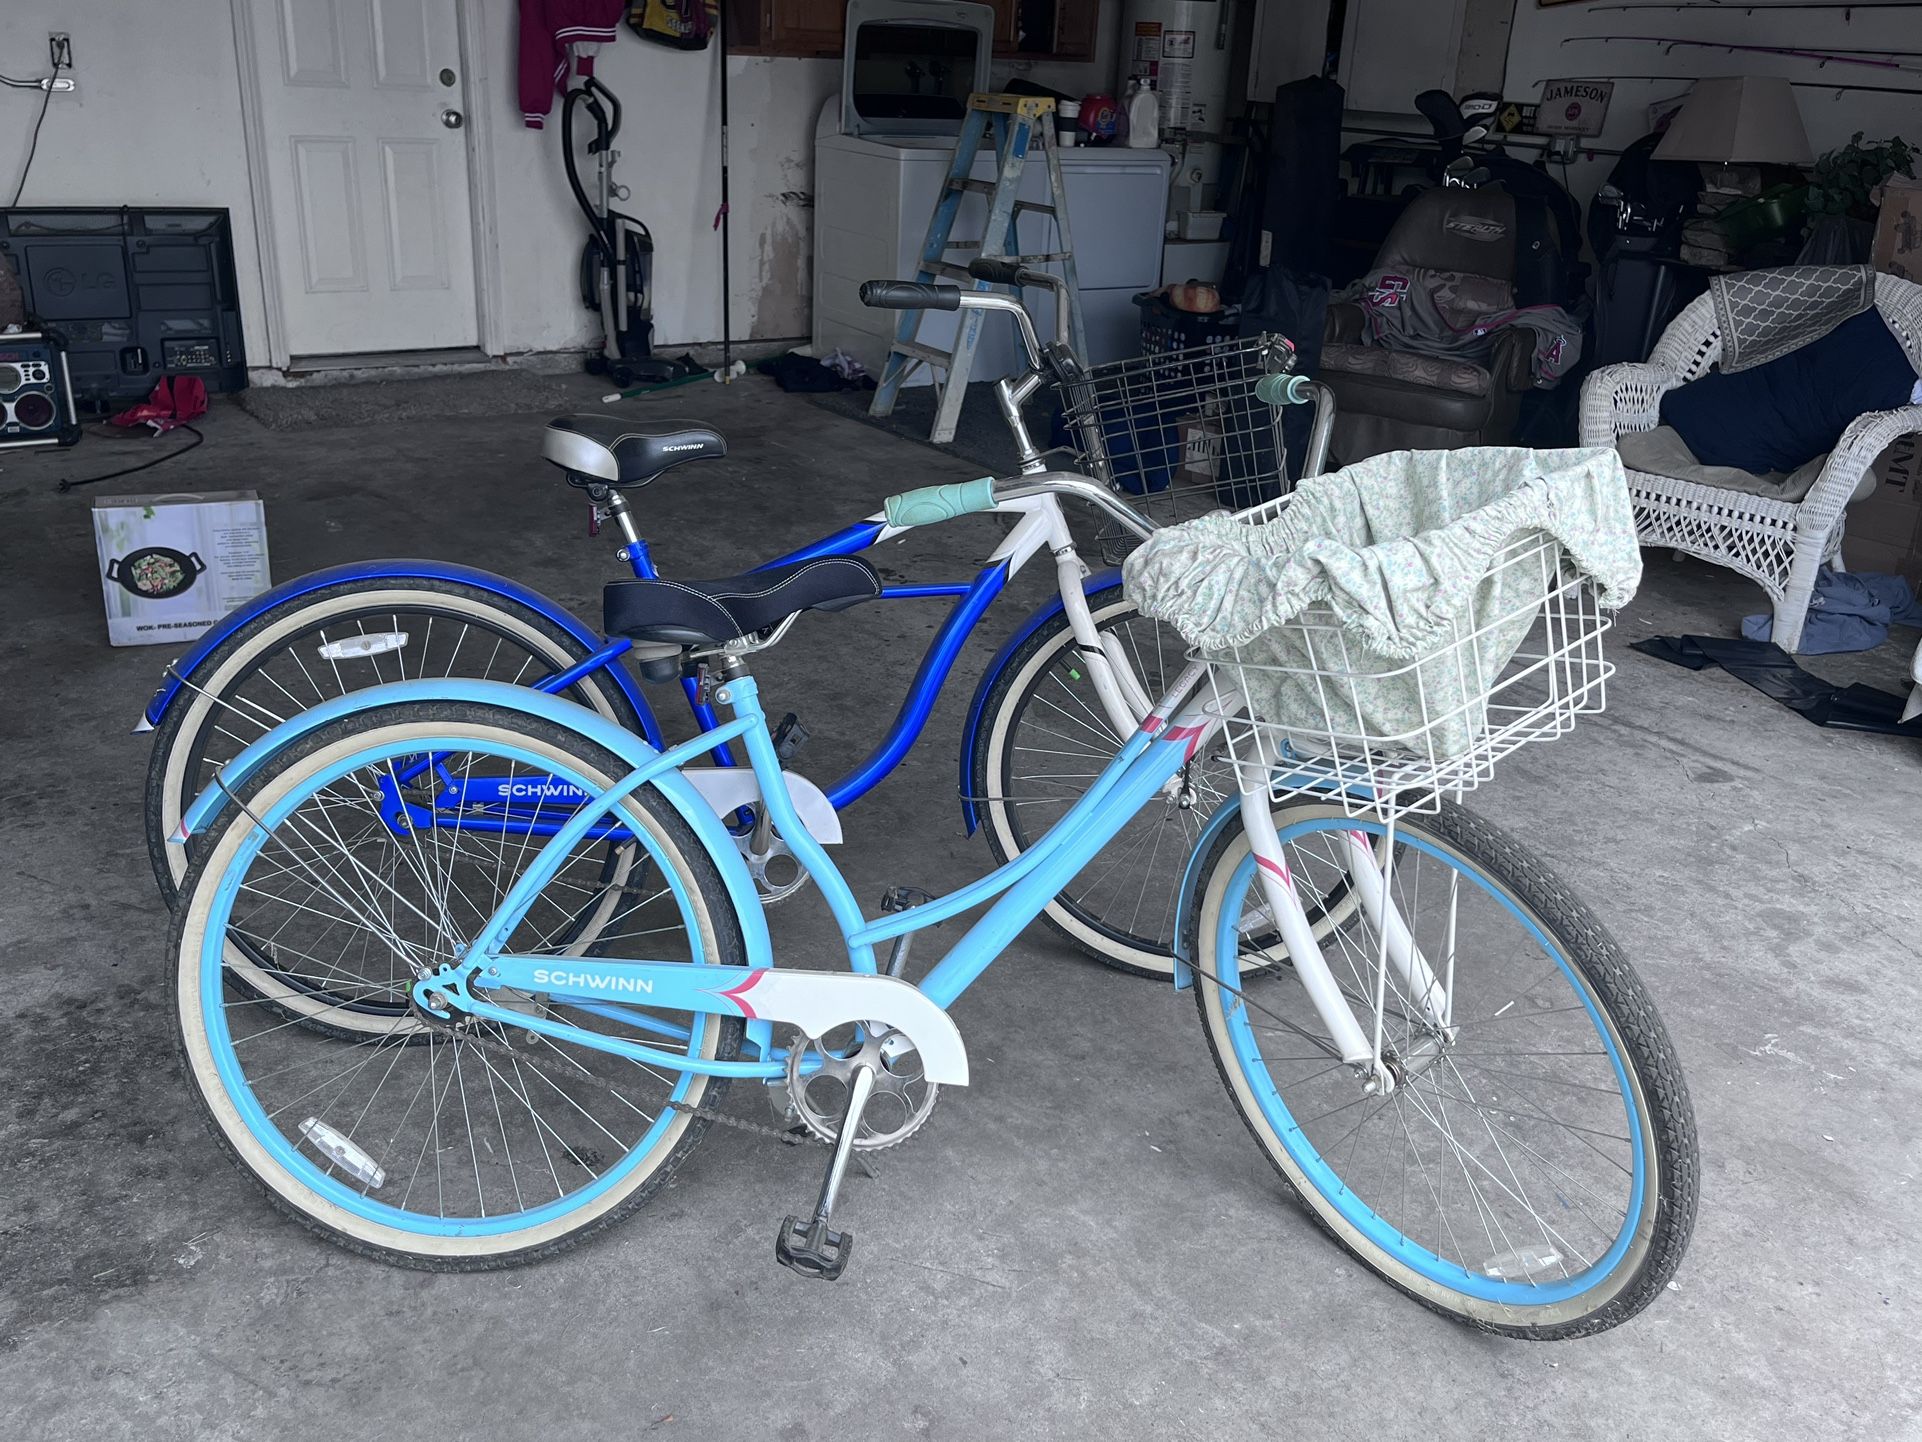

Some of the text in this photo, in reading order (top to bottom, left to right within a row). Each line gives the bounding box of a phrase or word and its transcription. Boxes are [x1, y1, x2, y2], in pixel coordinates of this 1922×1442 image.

[1546, 85, 1607, 103] JAMESON
[662, 443, 704, 452] SCHWINN
[157, 620, 212, 630] PRE-SEASONED
[497, 783, 588, 797] SCHWIN
[533, 968, 654, 994] SCHWINN
